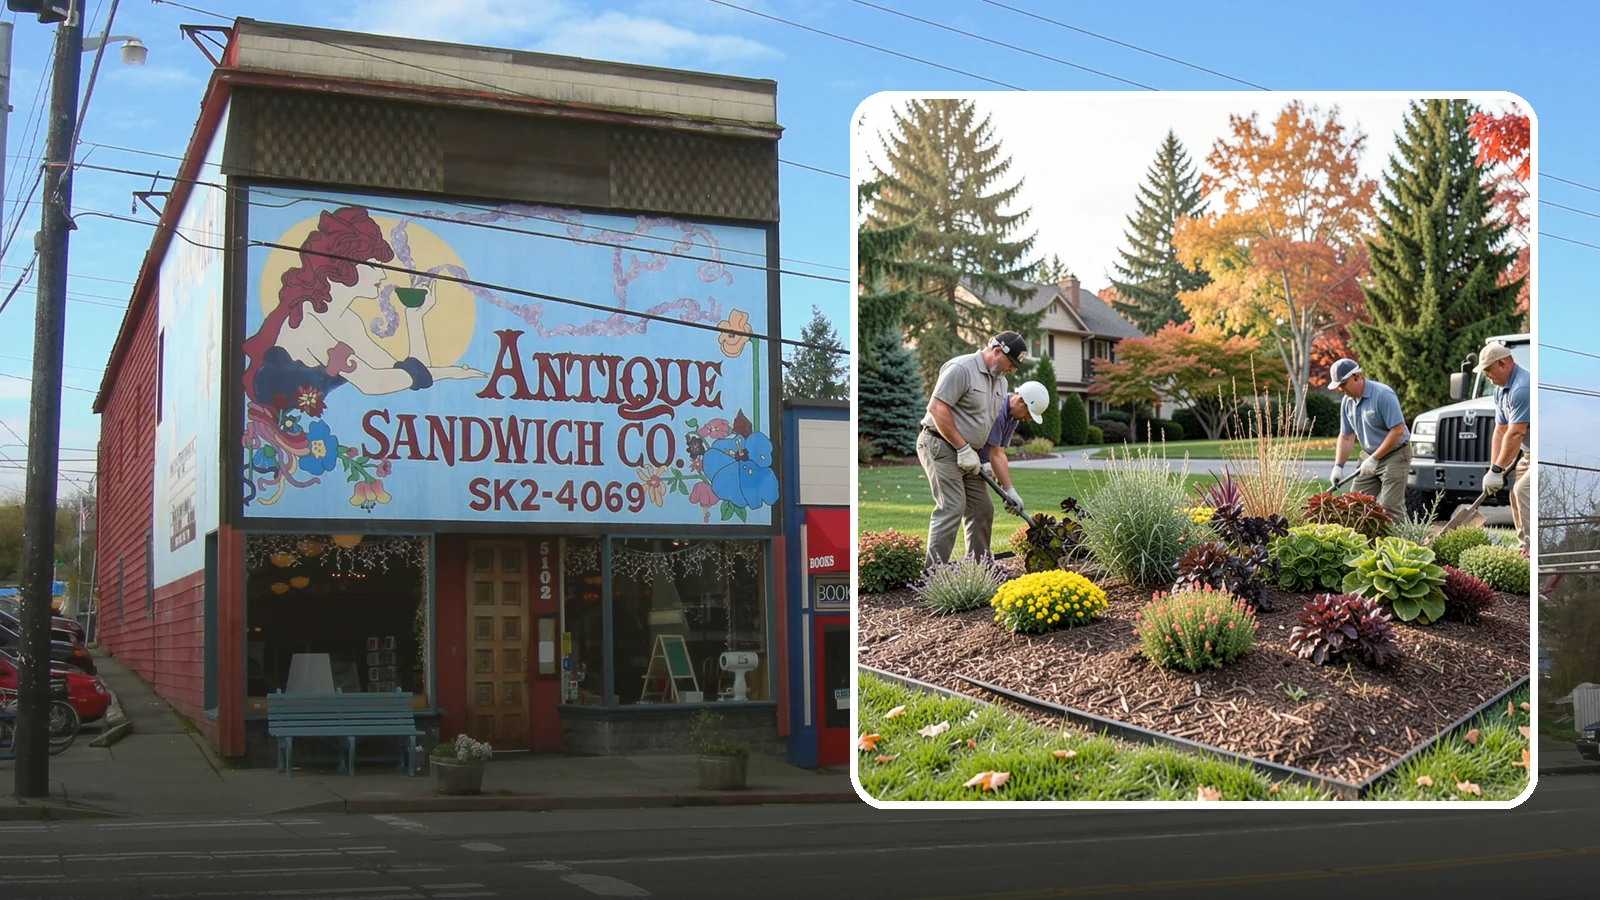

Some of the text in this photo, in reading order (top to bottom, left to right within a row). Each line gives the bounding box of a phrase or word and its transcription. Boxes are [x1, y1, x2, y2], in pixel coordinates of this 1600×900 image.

[475, 329, 723, 421] ANTIQUE
[361, 408, 685, 469] SANDWICH CO.
[468, 477, 646, 513] SK2-4069
[540, 541, 551, 600] 5102
[809, 555, 835, 569] BOOKS
